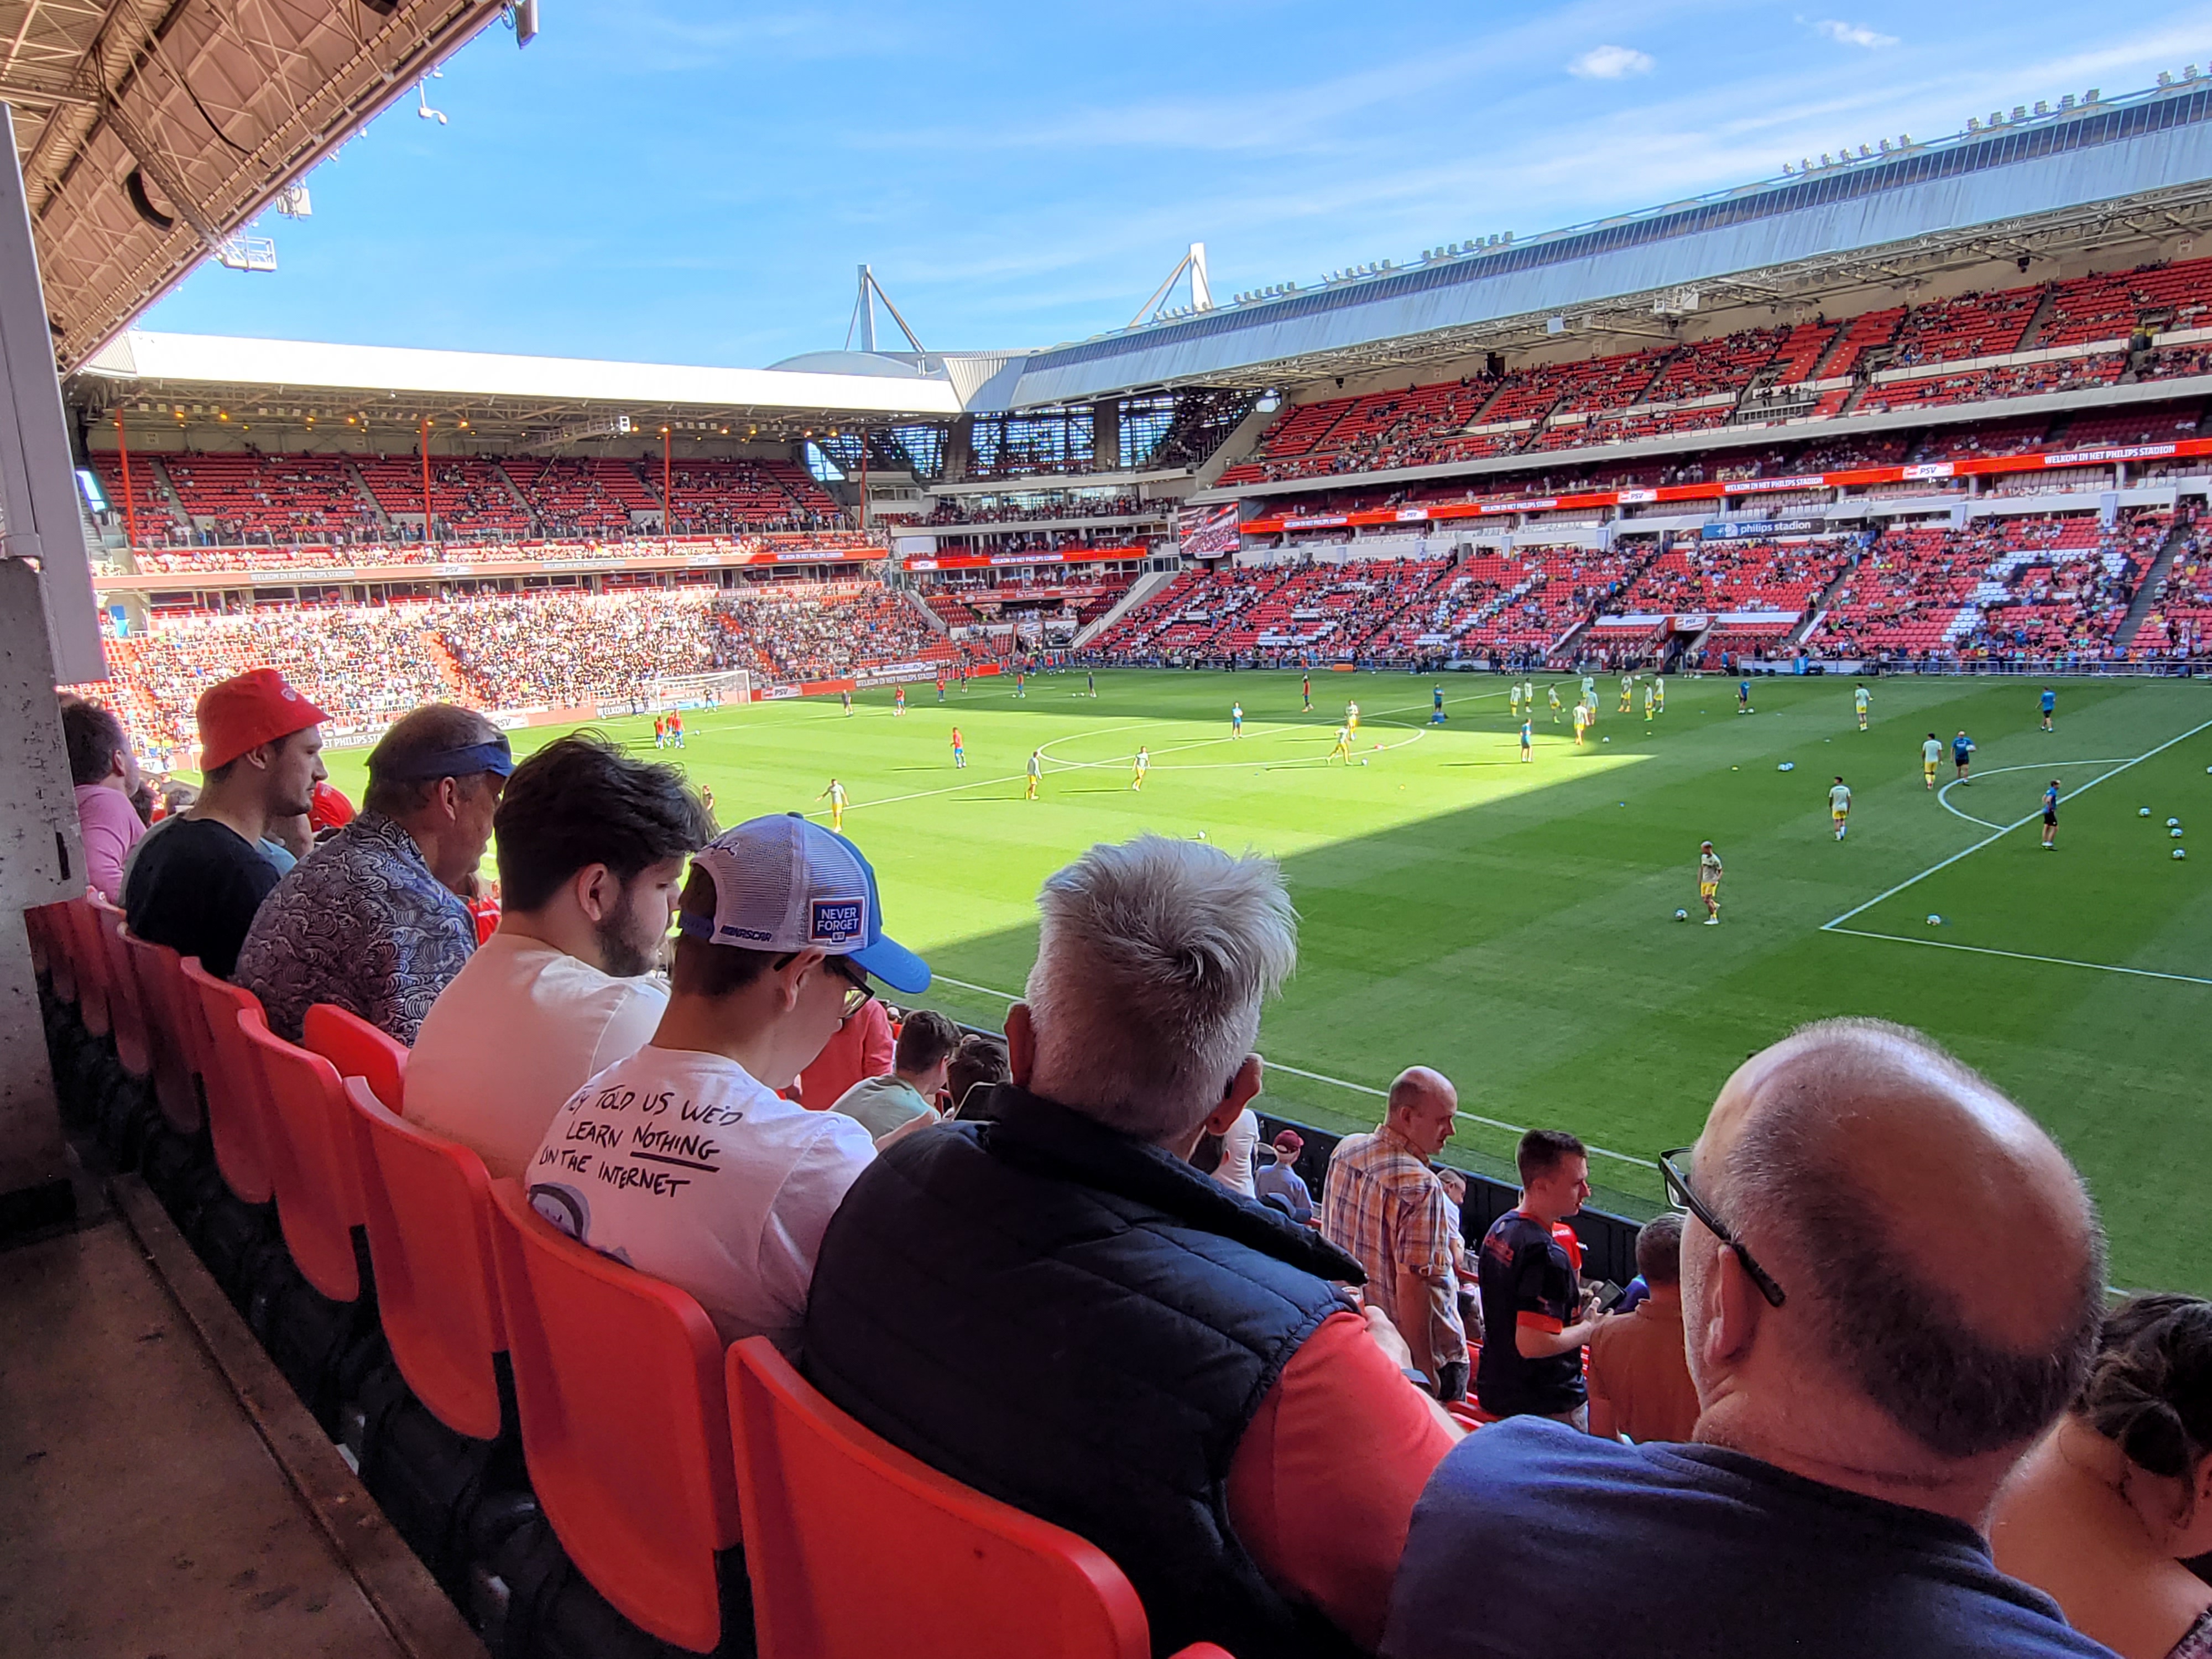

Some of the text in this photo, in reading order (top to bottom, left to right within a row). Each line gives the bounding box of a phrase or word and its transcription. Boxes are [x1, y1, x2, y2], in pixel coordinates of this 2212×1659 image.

[2044, 445, 2175, 464] WELKOM IN HET PHILIPS STADION
[1725, 483, 1750, 492] WELKOM
[1771, 479, 1796, 488] PHILIPS
[1796, 477, 1823, 486] STADION
[1740, 520, 1811, 535] philips stadion
[597, 705, 626, 716] WELKOM
[321, 739, 332, 748] ET
[333, 736, 367, 747] PHILIPS
[821, 907, 857, 919] NEVER
[817, 918, 859, 931] FORGET
[733, 928, 772, 942] NASCAR
[595, 1084, 635, 1111] TOLD
[643, 1092, 675, 1116] US
[681, 1099, 744, 1126] WE'D
[566, 1120, 721, 1160] LEARN NOTHING
[539, 1145, 691, 1198] ON THE INTERNET
